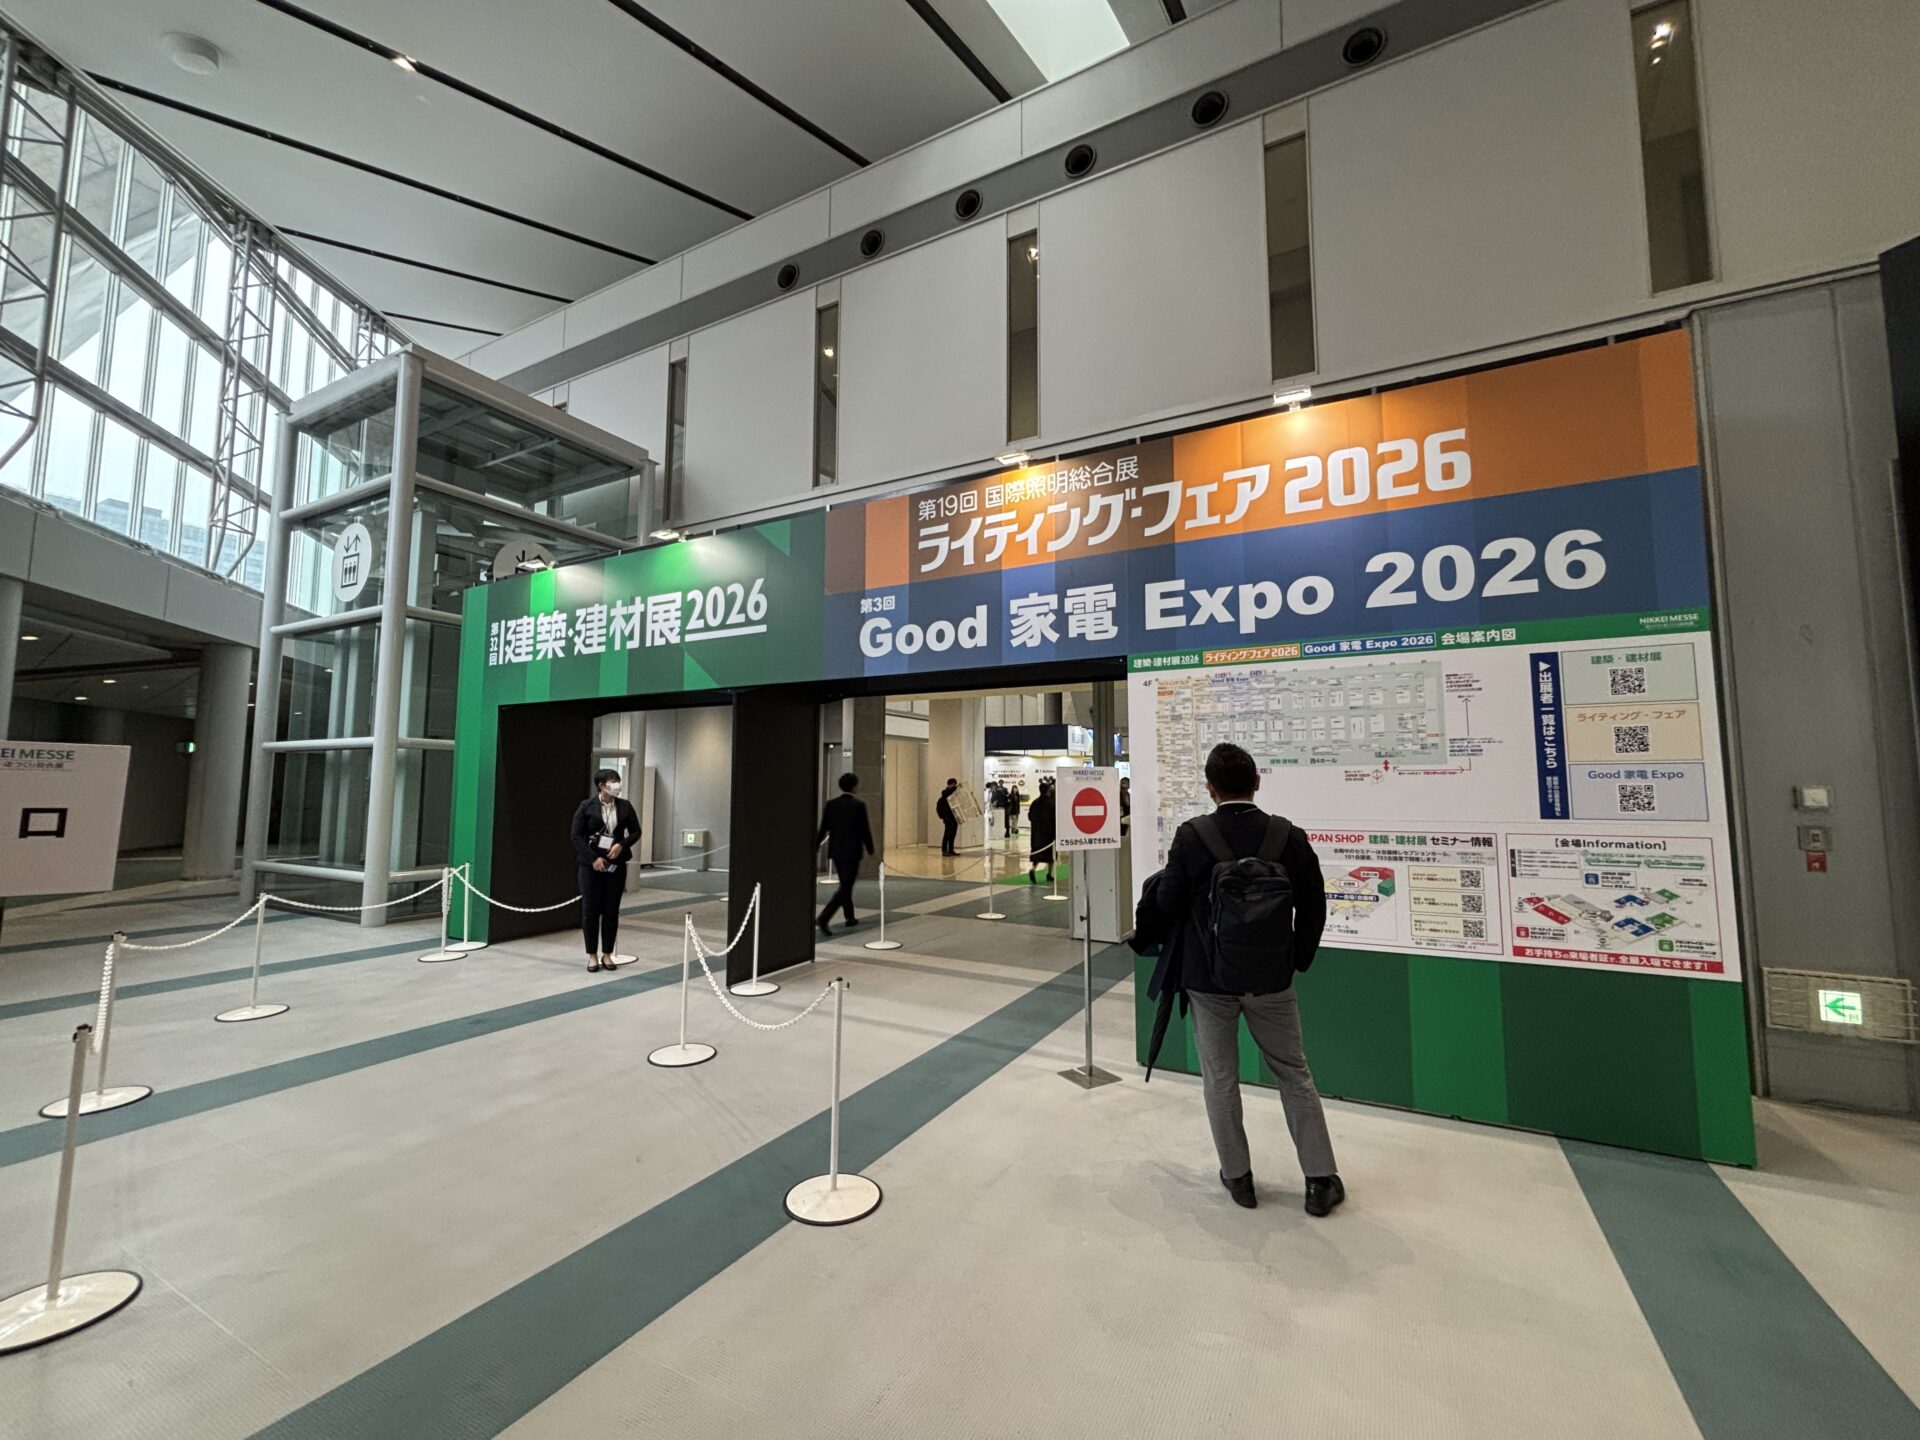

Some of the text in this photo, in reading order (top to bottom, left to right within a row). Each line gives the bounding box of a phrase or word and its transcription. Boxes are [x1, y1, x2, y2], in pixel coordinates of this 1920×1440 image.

[917, 455, 1140, 521] 第19回 国際照明総合展
[917, 427, 1472, 573] ライティング・フェア 2026
[859, 528, 1608, 659] Good 家電 Expo 2026
[859, 595, 896, 614] 第3回
[504, 577, 769, 664] 建築・建材展 2026
[1639, 613, 1699, 624] NIKKEI MESSE
[489, 622, 500, 666] 第32回
[1181, 653, 1199, 664] 2026
[1271, 645, 1298, 658] 2026
[1305, 642, 1336, 654] Good
[1339, 641, 1362, 652] 家電
[1366, 640, 1398, 651] Expo
[1401, 635, 1434, 646] 2026
[1441, 628, 1517, 645] 会場案内図
[1143, 679, 1153, 687] 4F
[1576, 709, 1686, 723] ライティング・フェア
[19, 749, 75, 760] MESSE
[1587, 769, 1685, 781] Good 家電 Expo
[1304, 834, 1333, 843] PAN
[1335, 834, 1364, 844] SHOP
[1430, 836, 1494, 848] セミナー情報
